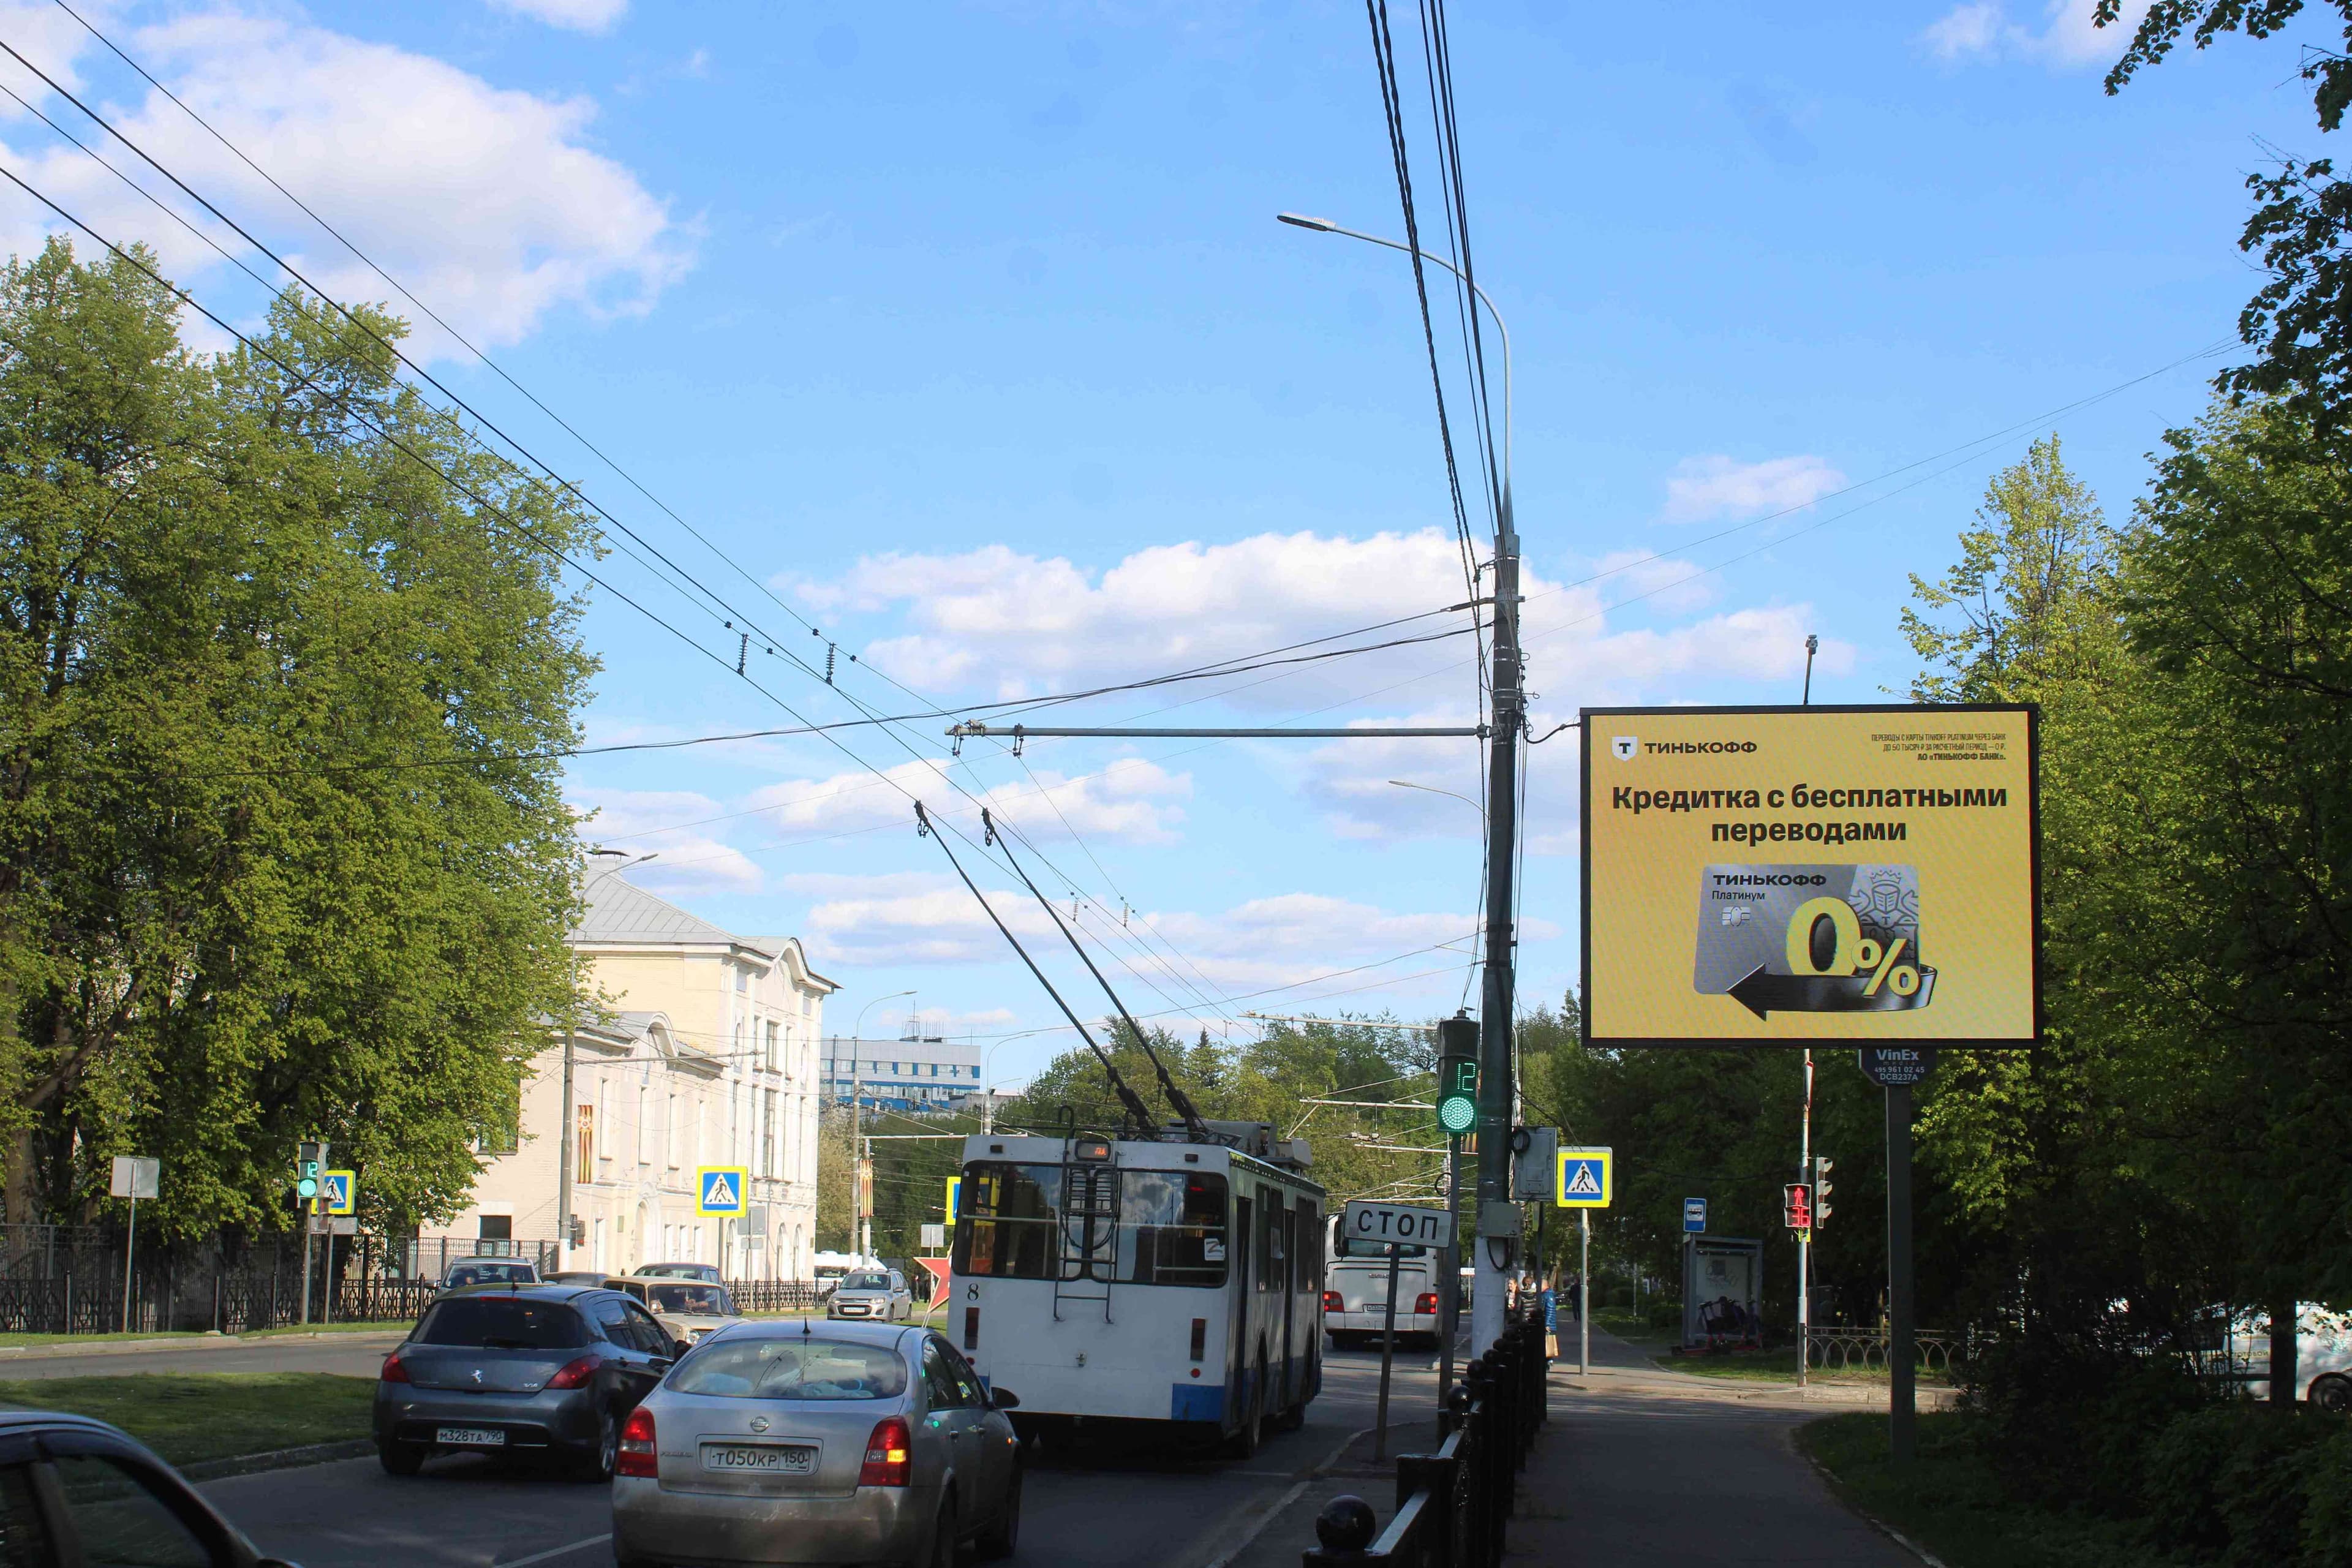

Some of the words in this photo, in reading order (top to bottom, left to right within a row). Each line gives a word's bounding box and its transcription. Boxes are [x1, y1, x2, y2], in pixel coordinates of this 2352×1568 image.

[1644, 741, 1757, 754] ТИНЬКОФФ
[1883, 744, 1891, 752] ДО
[1966, 743, 1987, 752] ПЕРИОД
[1613, 786, 1760, 814] Кредитка
[1767, 790, 1784, 808] с
[1791, 783, 2007, 808] бесплатными
[1711, 822, 1906, 846] переводами
[1713, 874, 1826, 886] ТИНЬКОФФ
[1712, 891, 1765, 902] Платинум
[1876, 1049, 1920, 1060] VinEx
[1457, 1063, 1476, 1091] 12
[307, 1162, 318, 1177] 12
[1358, 1209, 1438, 1240] СТОП
[1792, 1207, 1809, 1226] 36
[967, 1283, 979, 1301] 8
[716, 1450, 777, 1466] Т050КР
[782, 1452, 805, 1463] 150
